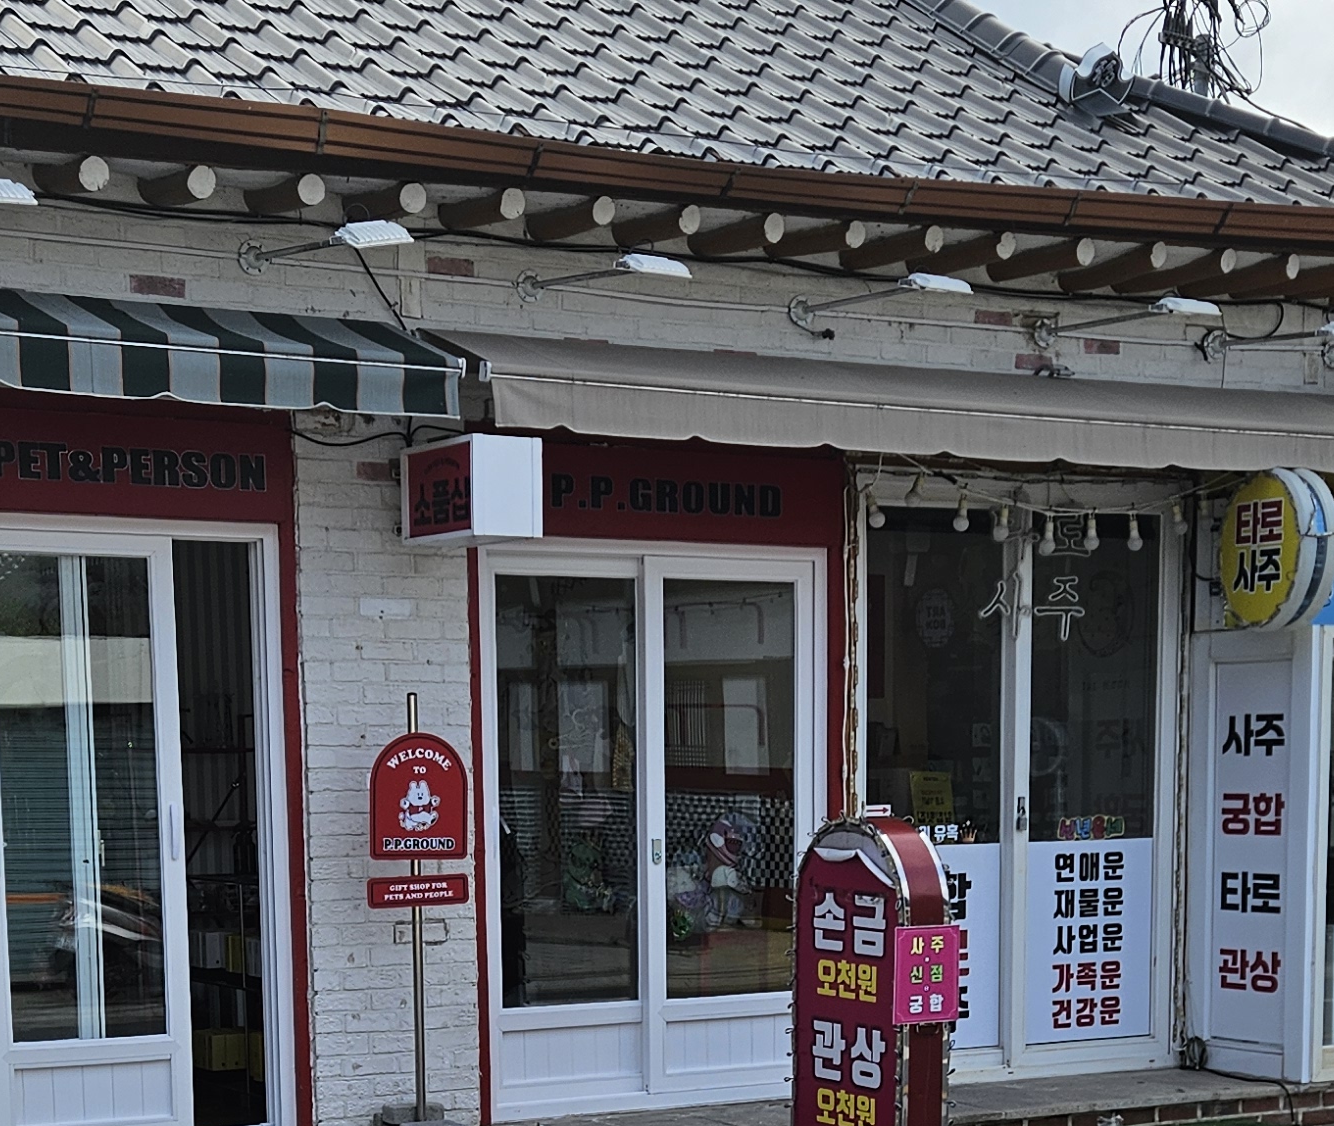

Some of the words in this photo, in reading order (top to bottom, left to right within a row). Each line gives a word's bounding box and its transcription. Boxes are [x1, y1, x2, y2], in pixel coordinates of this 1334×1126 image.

[549, 471, 784, 519] P.P.GROUND
[1233, 497, 1285, 546] 타로
[1231, 546, 1282, 593] 사주
[1221, 712, 1286, 757] 사주
[386, 748, 452, 771] WELCOME
[413, 766, 427, 774] TO
[1220, 792, 1285, 837] 궁합
[383, 837, 455, 851] P.P.GROUND
[933, 824, 959, 841] 유혹
[384, 893, 404, 901] PETS
[424, 890, 454, 898] PEOPLE
[1053, 886, 1125, 919] 재물운
[1219, 870, 1282, 914] 타로
[813, 891, 887, 957] 손금
[1052, 922, 1124, 955] 사업운
[910, 936, 944, 955] 사주
[817, 958, 878, 1003] 오천원
[910, 964, 944, 984] 신점
[1051, 960, 1122, 993] 가족운
[1218, 948, 1282, 994] 관상
[909, 993, 944, 1014] 궁합
[1051, 996, 1121, 1029] 건강운
[812, 1019, 886, 1089] 관상
